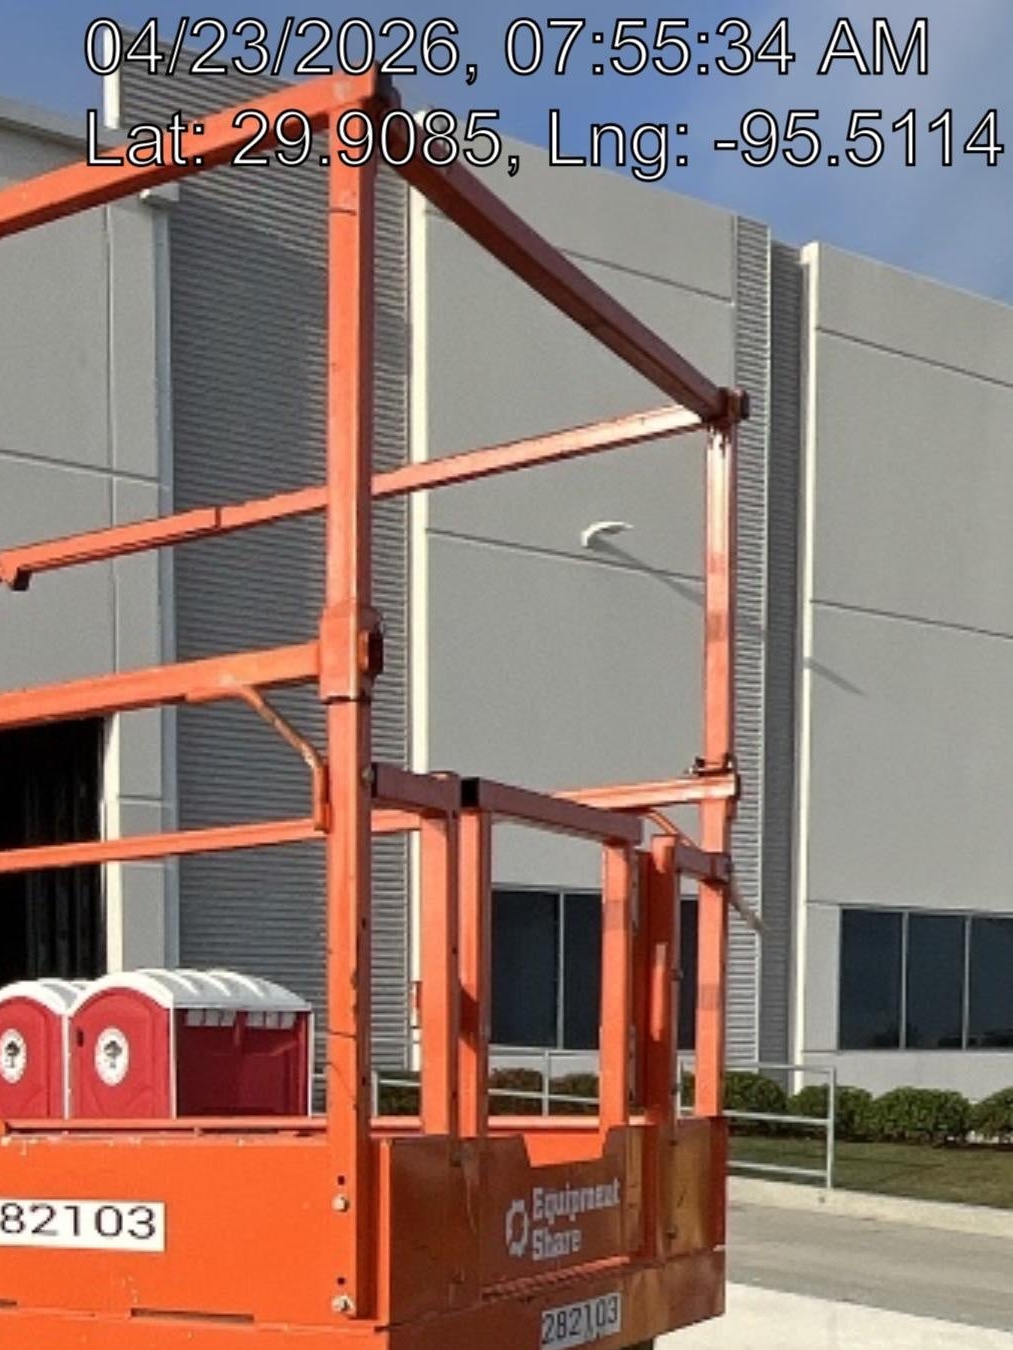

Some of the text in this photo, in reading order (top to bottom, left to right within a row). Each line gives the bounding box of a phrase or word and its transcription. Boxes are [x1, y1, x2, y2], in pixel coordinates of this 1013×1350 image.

[532, 1177, 620, 1226] Equipment
[532, 1228, 582, 1261] Share
[541, 1296, 618, 1344] 282103
